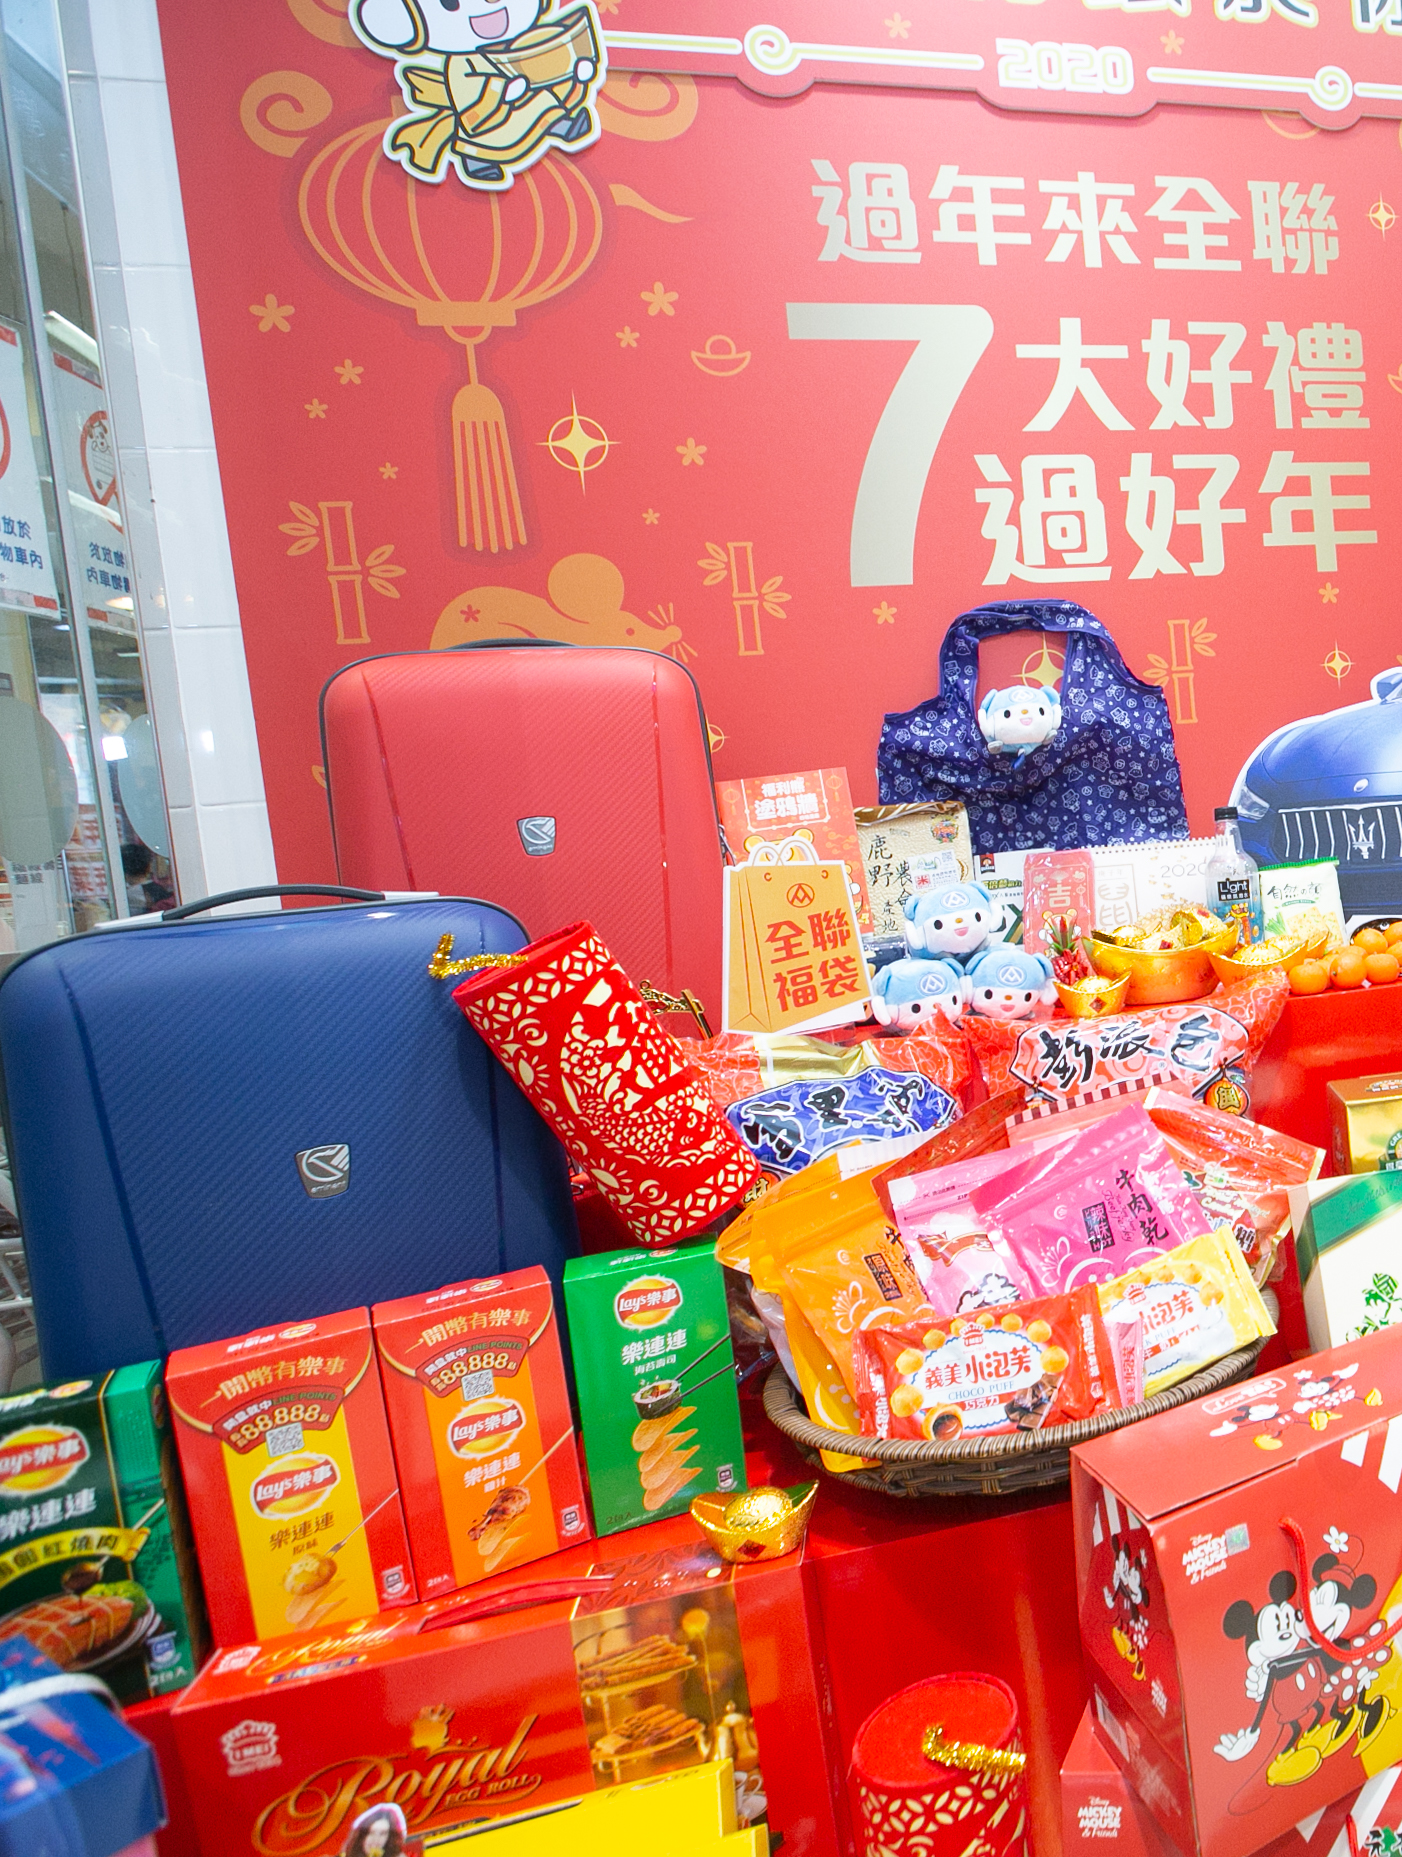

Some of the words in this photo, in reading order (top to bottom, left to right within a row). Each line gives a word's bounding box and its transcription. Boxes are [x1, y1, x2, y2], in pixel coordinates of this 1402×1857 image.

[996, 38, 1134, 95] 2020
[810, 158, 1340, 275] 過年來全聯
[1014, 317, 1371, 432] 大好禮
[786, 302, 994, 588] 7
[0, 515, 32, 540] 放於
[973, 451, 1379, 587] 過好年
[867, 834, 894, 887] 鹿野
[1049, 885, 1071, 907] 吉
[765, 912, 851, 965] 全聯
[772, 955, 862, 1012] 福袋
[1116, 1169, 1169, 1246] 牛肉乾
[420, 1308, 533, 1348] 開幣有樂事
[621, 1328, 688, 1366] 樂連連
[219, 1356, 348, 1400] 開幣有樂事
[948, 1386, 985, 1401] CHOCO
[989, 1381, 1015, 1393] PUFF
[964, 1395, 1000, 1411] 巧克力
[463, 1452, 522, 1488] 樂連連
[269, 1511, 335, 1551] 樂連連
[250, 1713, 539, 1857] Royal
[446, 1789, 482, 1806] EGG
[485, 1777, 532, 1799] ROLL
[1077, 1806, 1122, 1818] MICKEY
[1079, 1817, 1121, 1828] MOUSE
